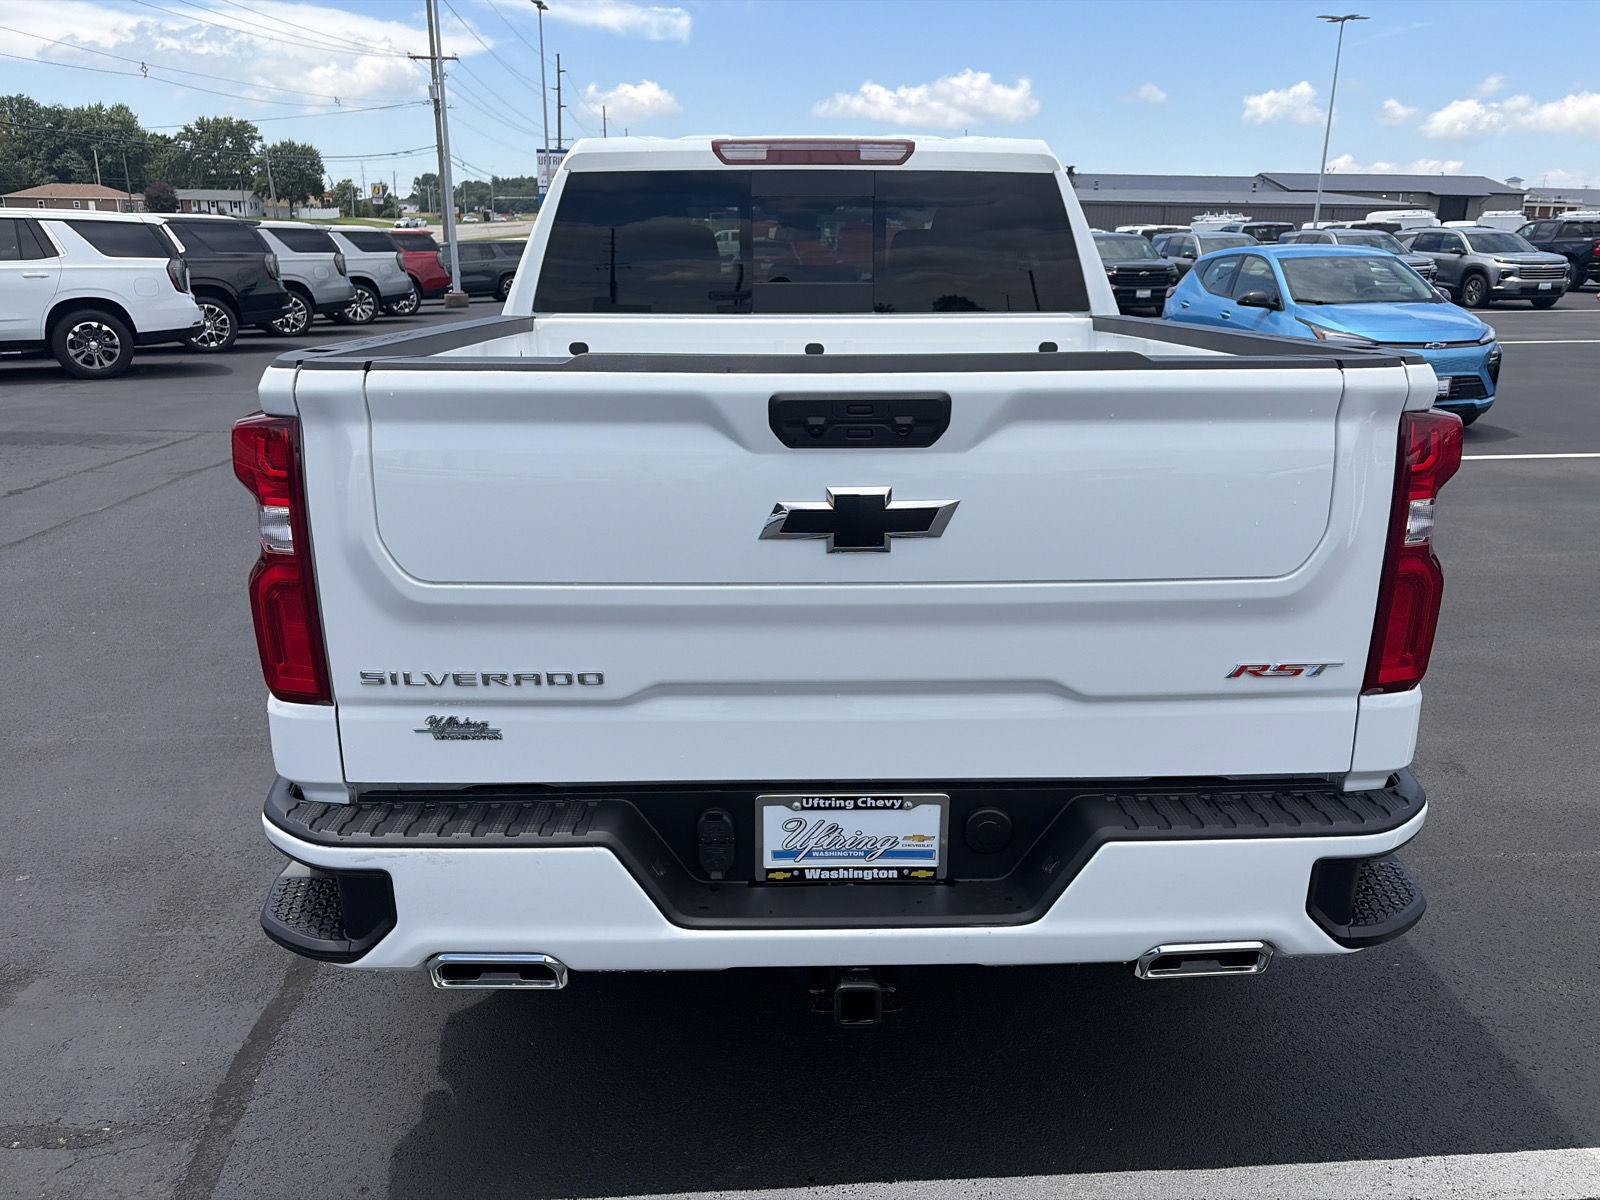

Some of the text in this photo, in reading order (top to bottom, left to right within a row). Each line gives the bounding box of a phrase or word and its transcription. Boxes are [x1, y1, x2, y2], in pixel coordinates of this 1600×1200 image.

[1224, 662, 1345, 679] RST
[359, 670, 605, 687] SILVERADO
[432, 732, 503, 741] WASHINGTON
[802, 797, 902, 809] Uftring Chevy
[781, 817, 900, 863] Uftring
[804, 868, 898, 880] Washington
